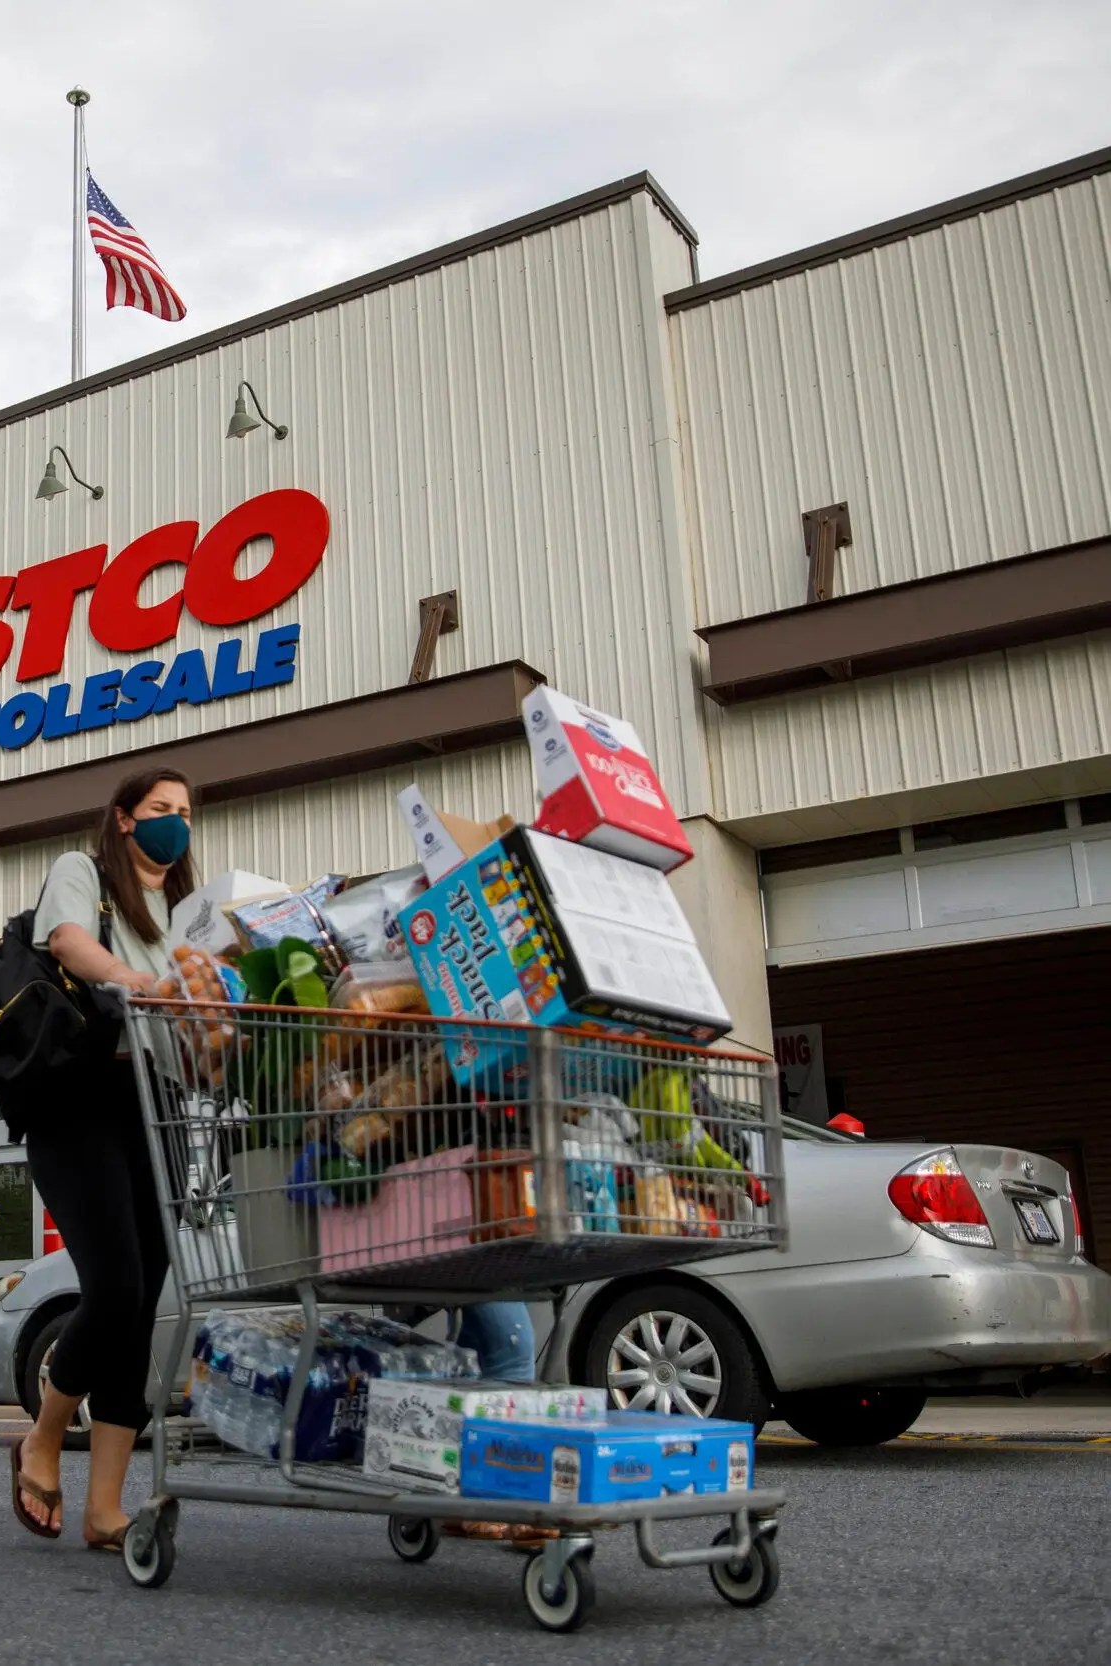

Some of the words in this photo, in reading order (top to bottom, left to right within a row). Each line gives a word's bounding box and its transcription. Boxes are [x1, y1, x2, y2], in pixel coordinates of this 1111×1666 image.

[446, 881, 500, 964] Pack
[437, 922, 507, 1021] Snack
[774, 1033, 811, 1067] ING
[392, 1398, 410, 1434] WHITE
[410, 1395, 435, 1419] CLAW
